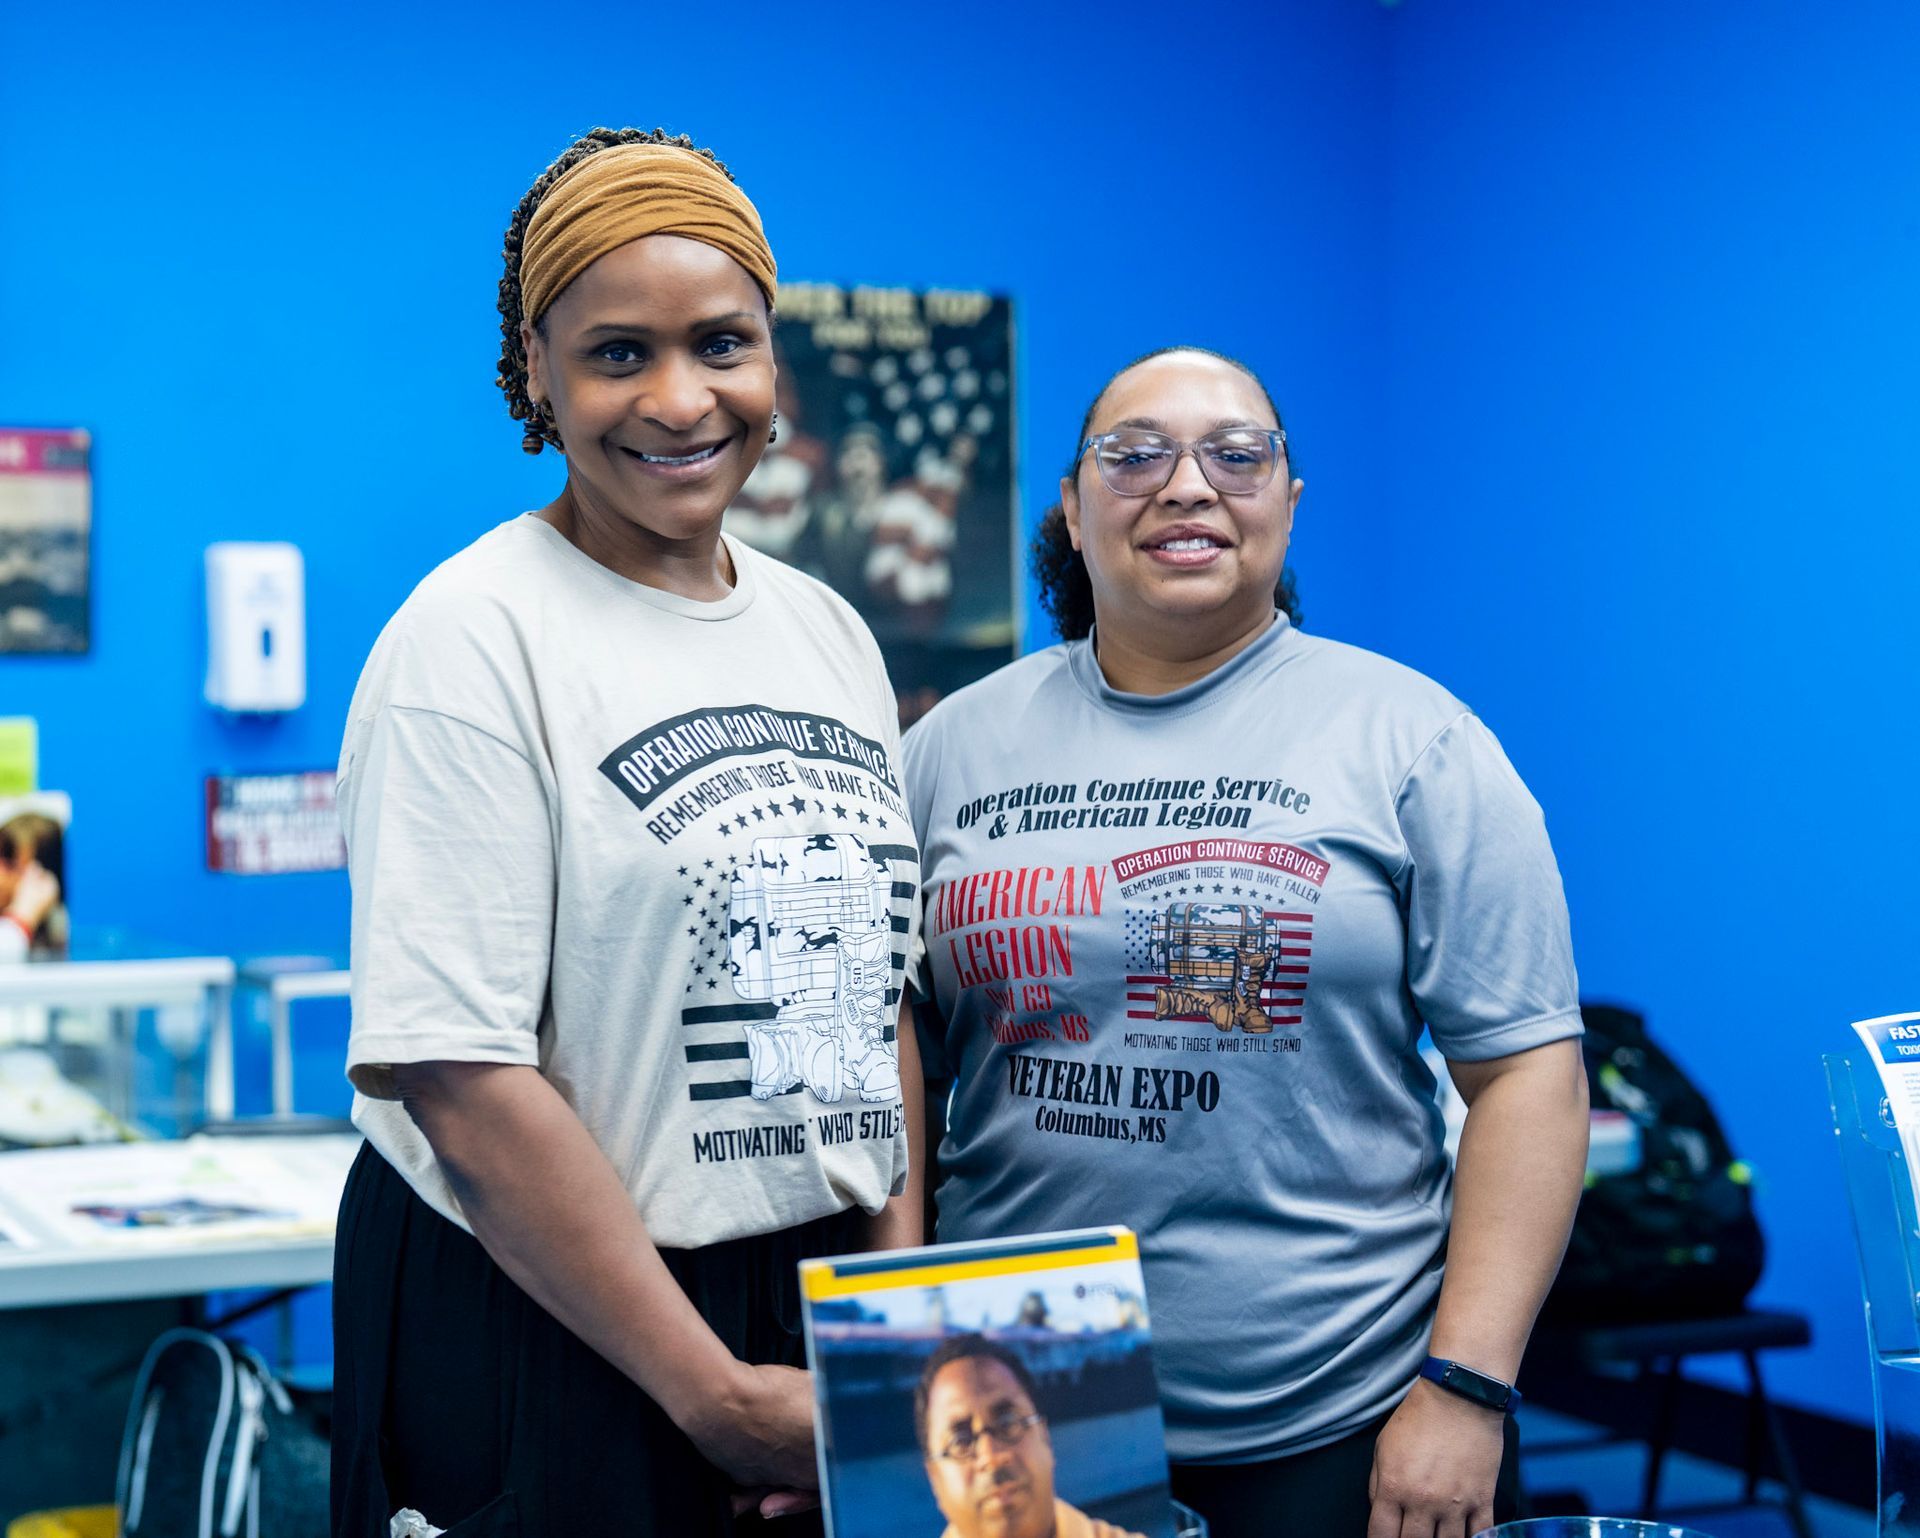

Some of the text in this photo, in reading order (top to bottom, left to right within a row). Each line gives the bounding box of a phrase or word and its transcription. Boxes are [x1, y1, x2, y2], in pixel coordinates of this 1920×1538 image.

[618, 711, 897, 795] OPERATION CONTINUE SERVICE
[646, 763, 753, 845] REMEMBERING
[746, 760, 796, 790] THOSE
[825, 769, 867, 799] HAVE
[956, 776, 1311, 830] Operation Continue Service
[988, 802, 1252, 841] & American Legion
[1117, 841, 1325, 882] OPERATION CONTINUE SERVICE
[1120, 866, 1321, 905] REMEMBERING THOSE WHO HAVE FALLEN
[933, 865, 1108, 938] AMERICAN
[948, 924, 1073, 989] LEGION
[1022, 984, 1053, 1013] 69
[1060, 1014, 1090, 1043] MS
[1124, 1033, 1301, 1053] MOTIVATING THOSE WHO STILL STAND
[1007, 1055, 1220, 1113] VETERAN EXPO
[693, 1123, 806, 1164] MOTIVATING
[817, 1112, 854, 1146] WHO
[859, 1109, 895, 1140] STIL
